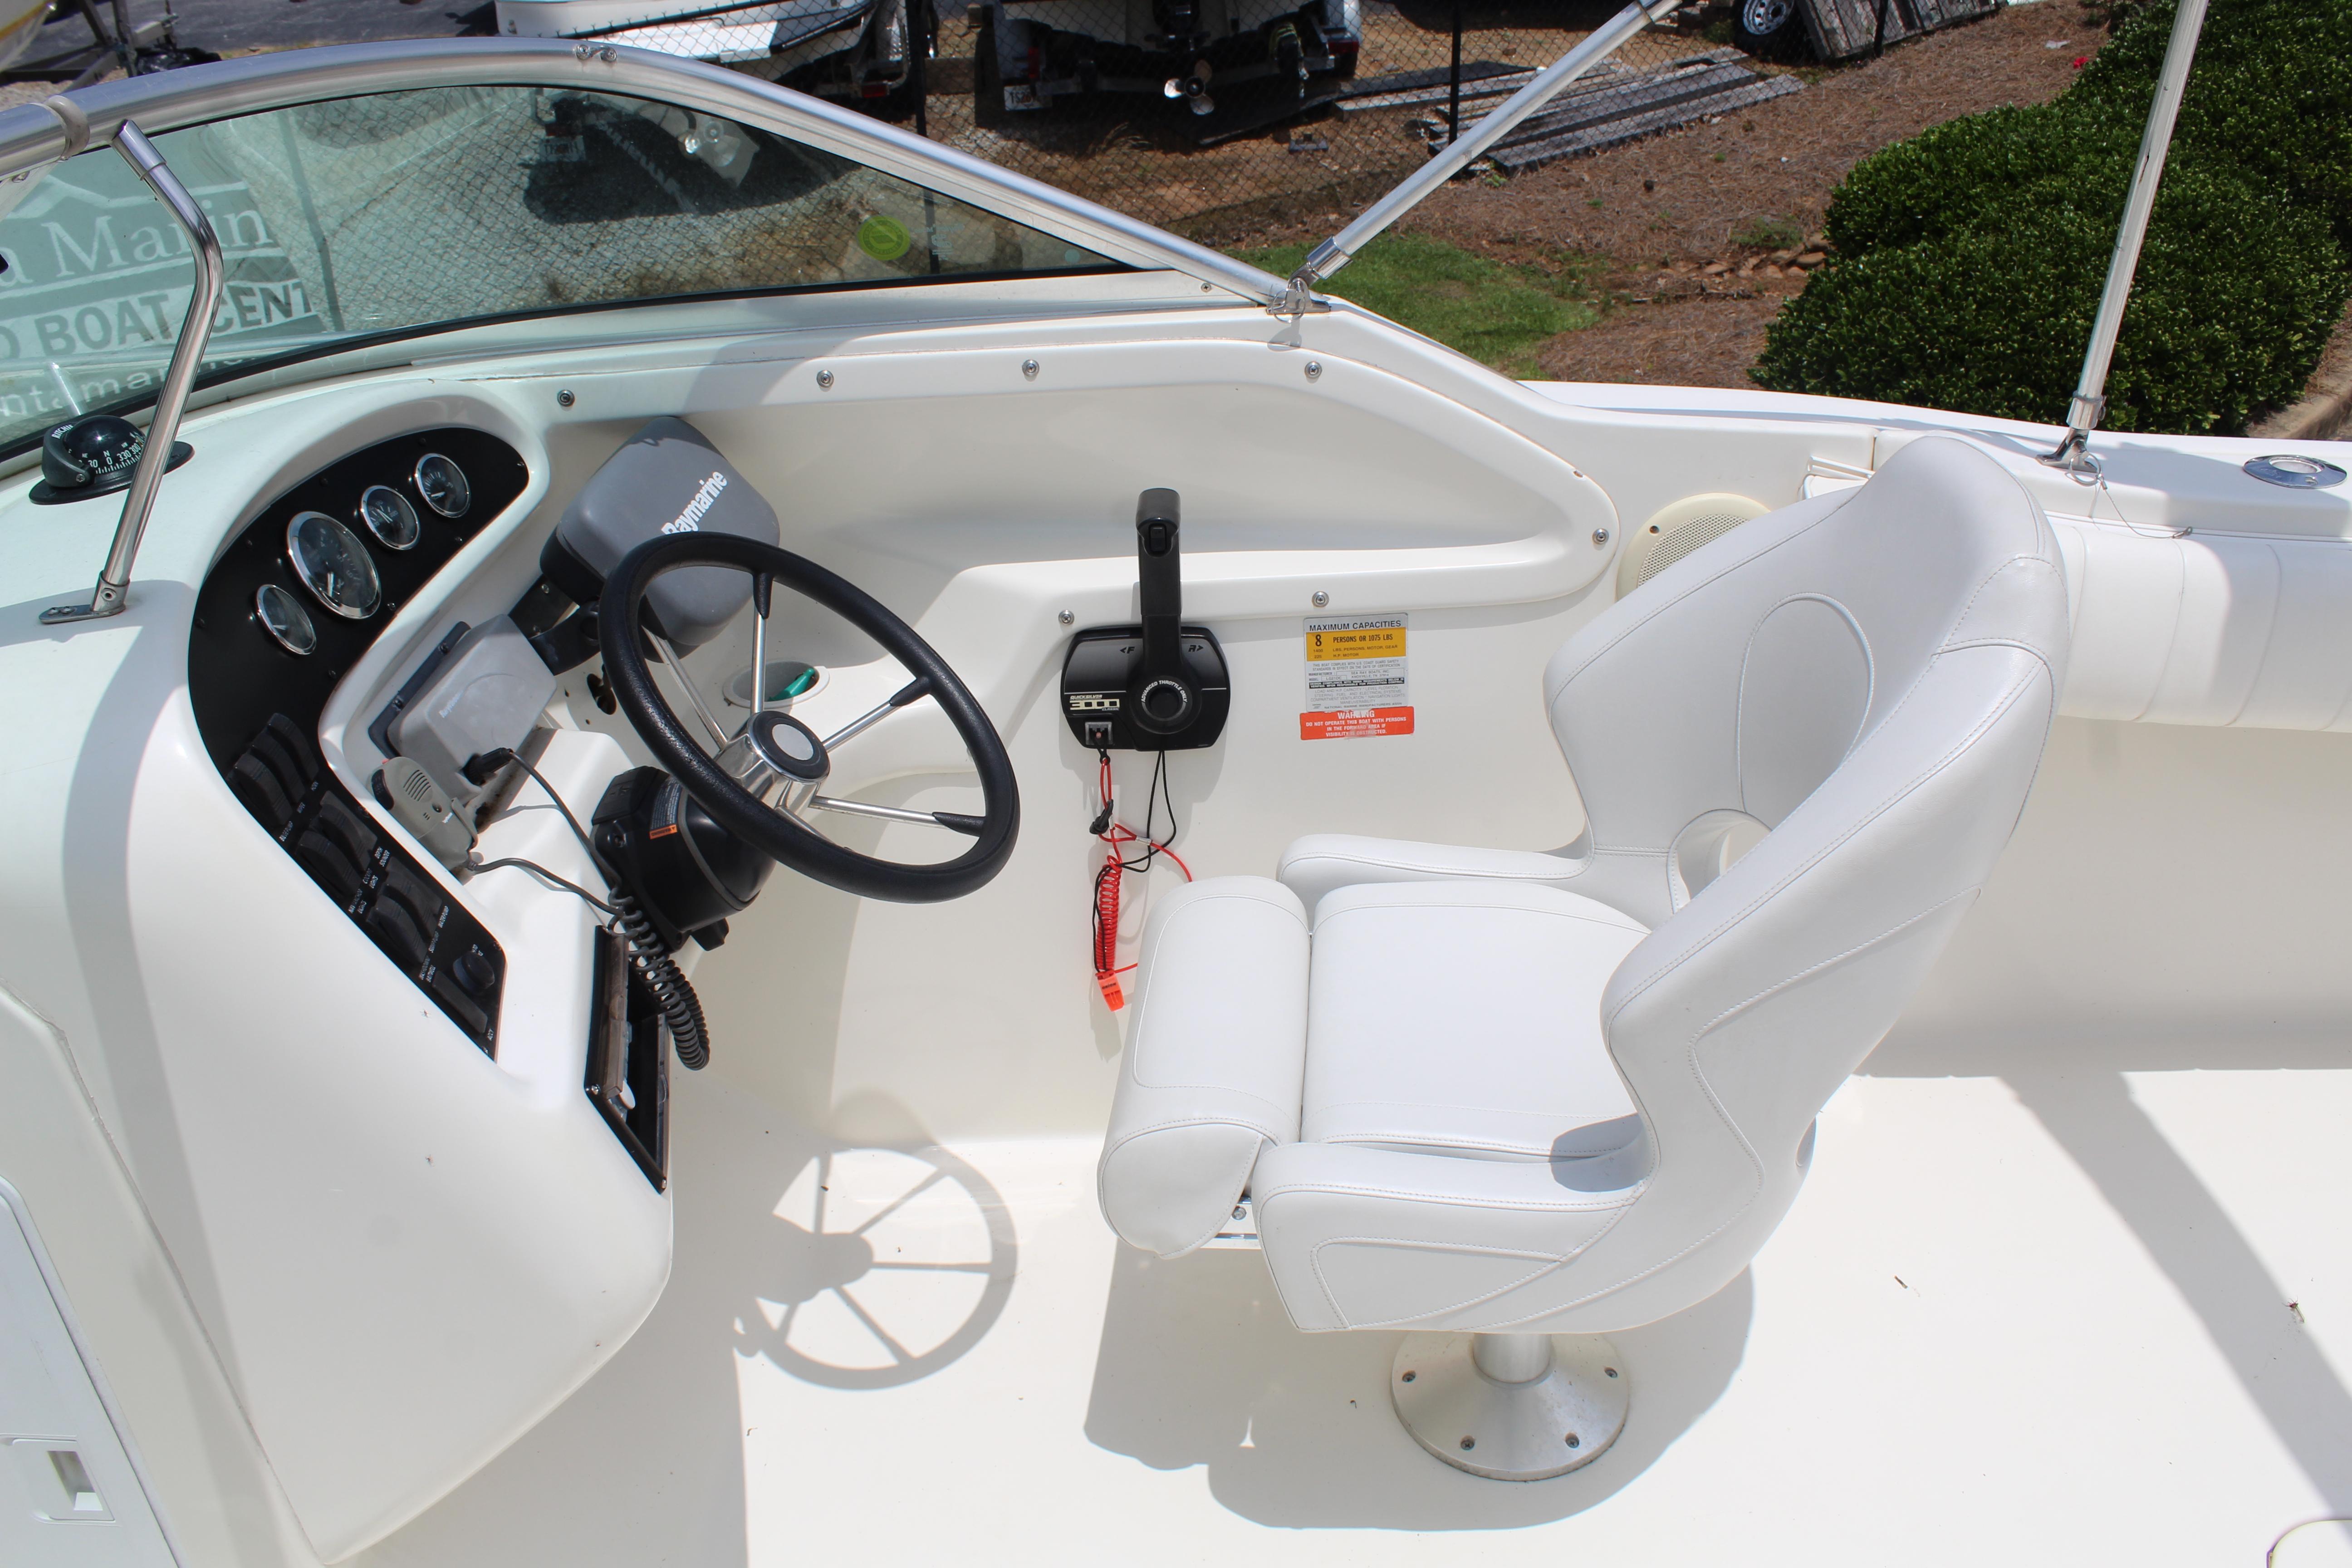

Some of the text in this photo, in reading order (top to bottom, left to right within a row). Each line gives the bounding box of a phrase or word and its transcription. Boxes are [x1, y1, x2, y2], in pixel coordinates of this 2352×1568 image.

[34, 293, 173, 357] BOAT
[129, 443, 141, 454] 300
[106, 457, 113, 465] 0
[117, 450, 132, 461] 330
[661, 471, 728, 534] Raymarine
[1309, 620, 1401, 632] MAXIMUM CAPACITIES
[1315, 634, 1322, 647] 8
[1140, 680, 1188, 703] ADVANCED THROTTLE ONLY
[1069, 699, 1120, 710] 3000
[369, 875, 378, 889] LIGHTS
